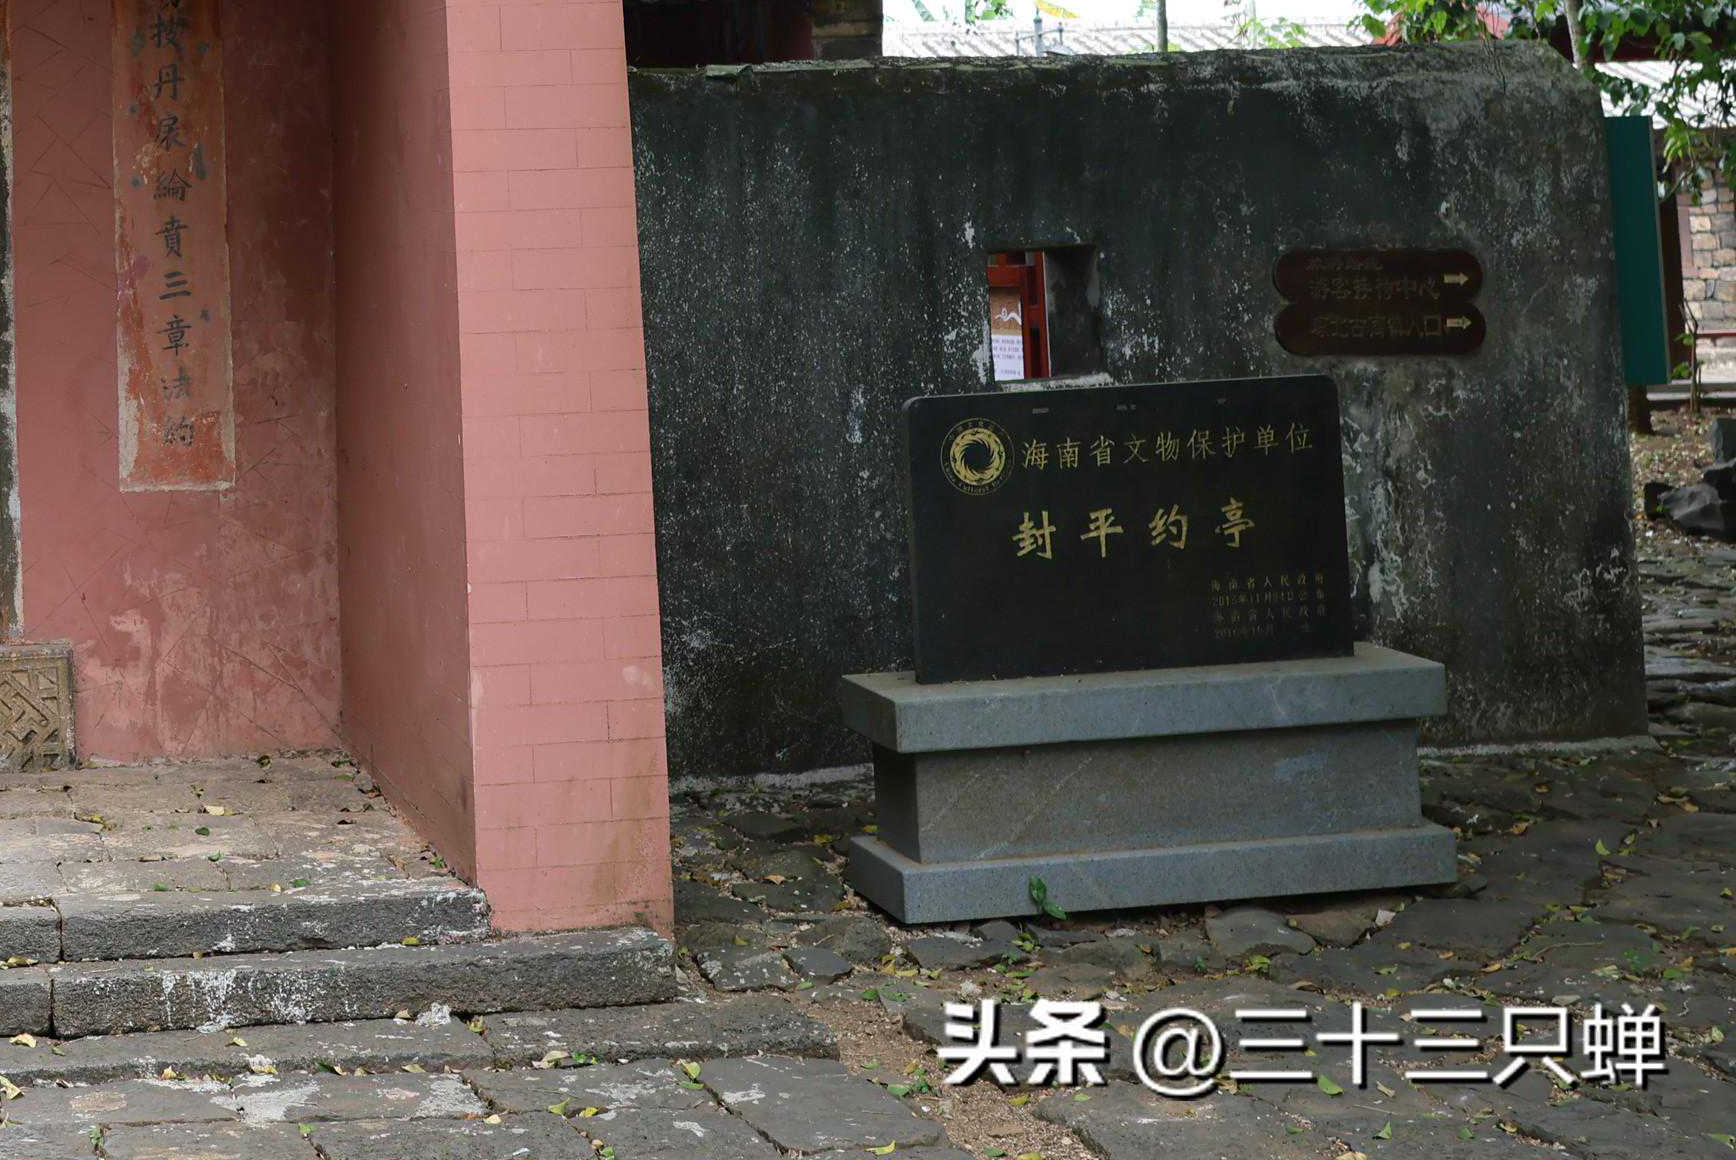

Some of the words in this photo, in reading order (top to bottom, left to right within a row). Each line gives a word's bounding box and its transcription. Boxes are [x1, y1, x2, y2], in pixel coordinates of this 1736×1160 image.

[1021, 422, 1313, 472] 海南省文物保护单位
[1013, 497, 1255, 560] 封平约亭
